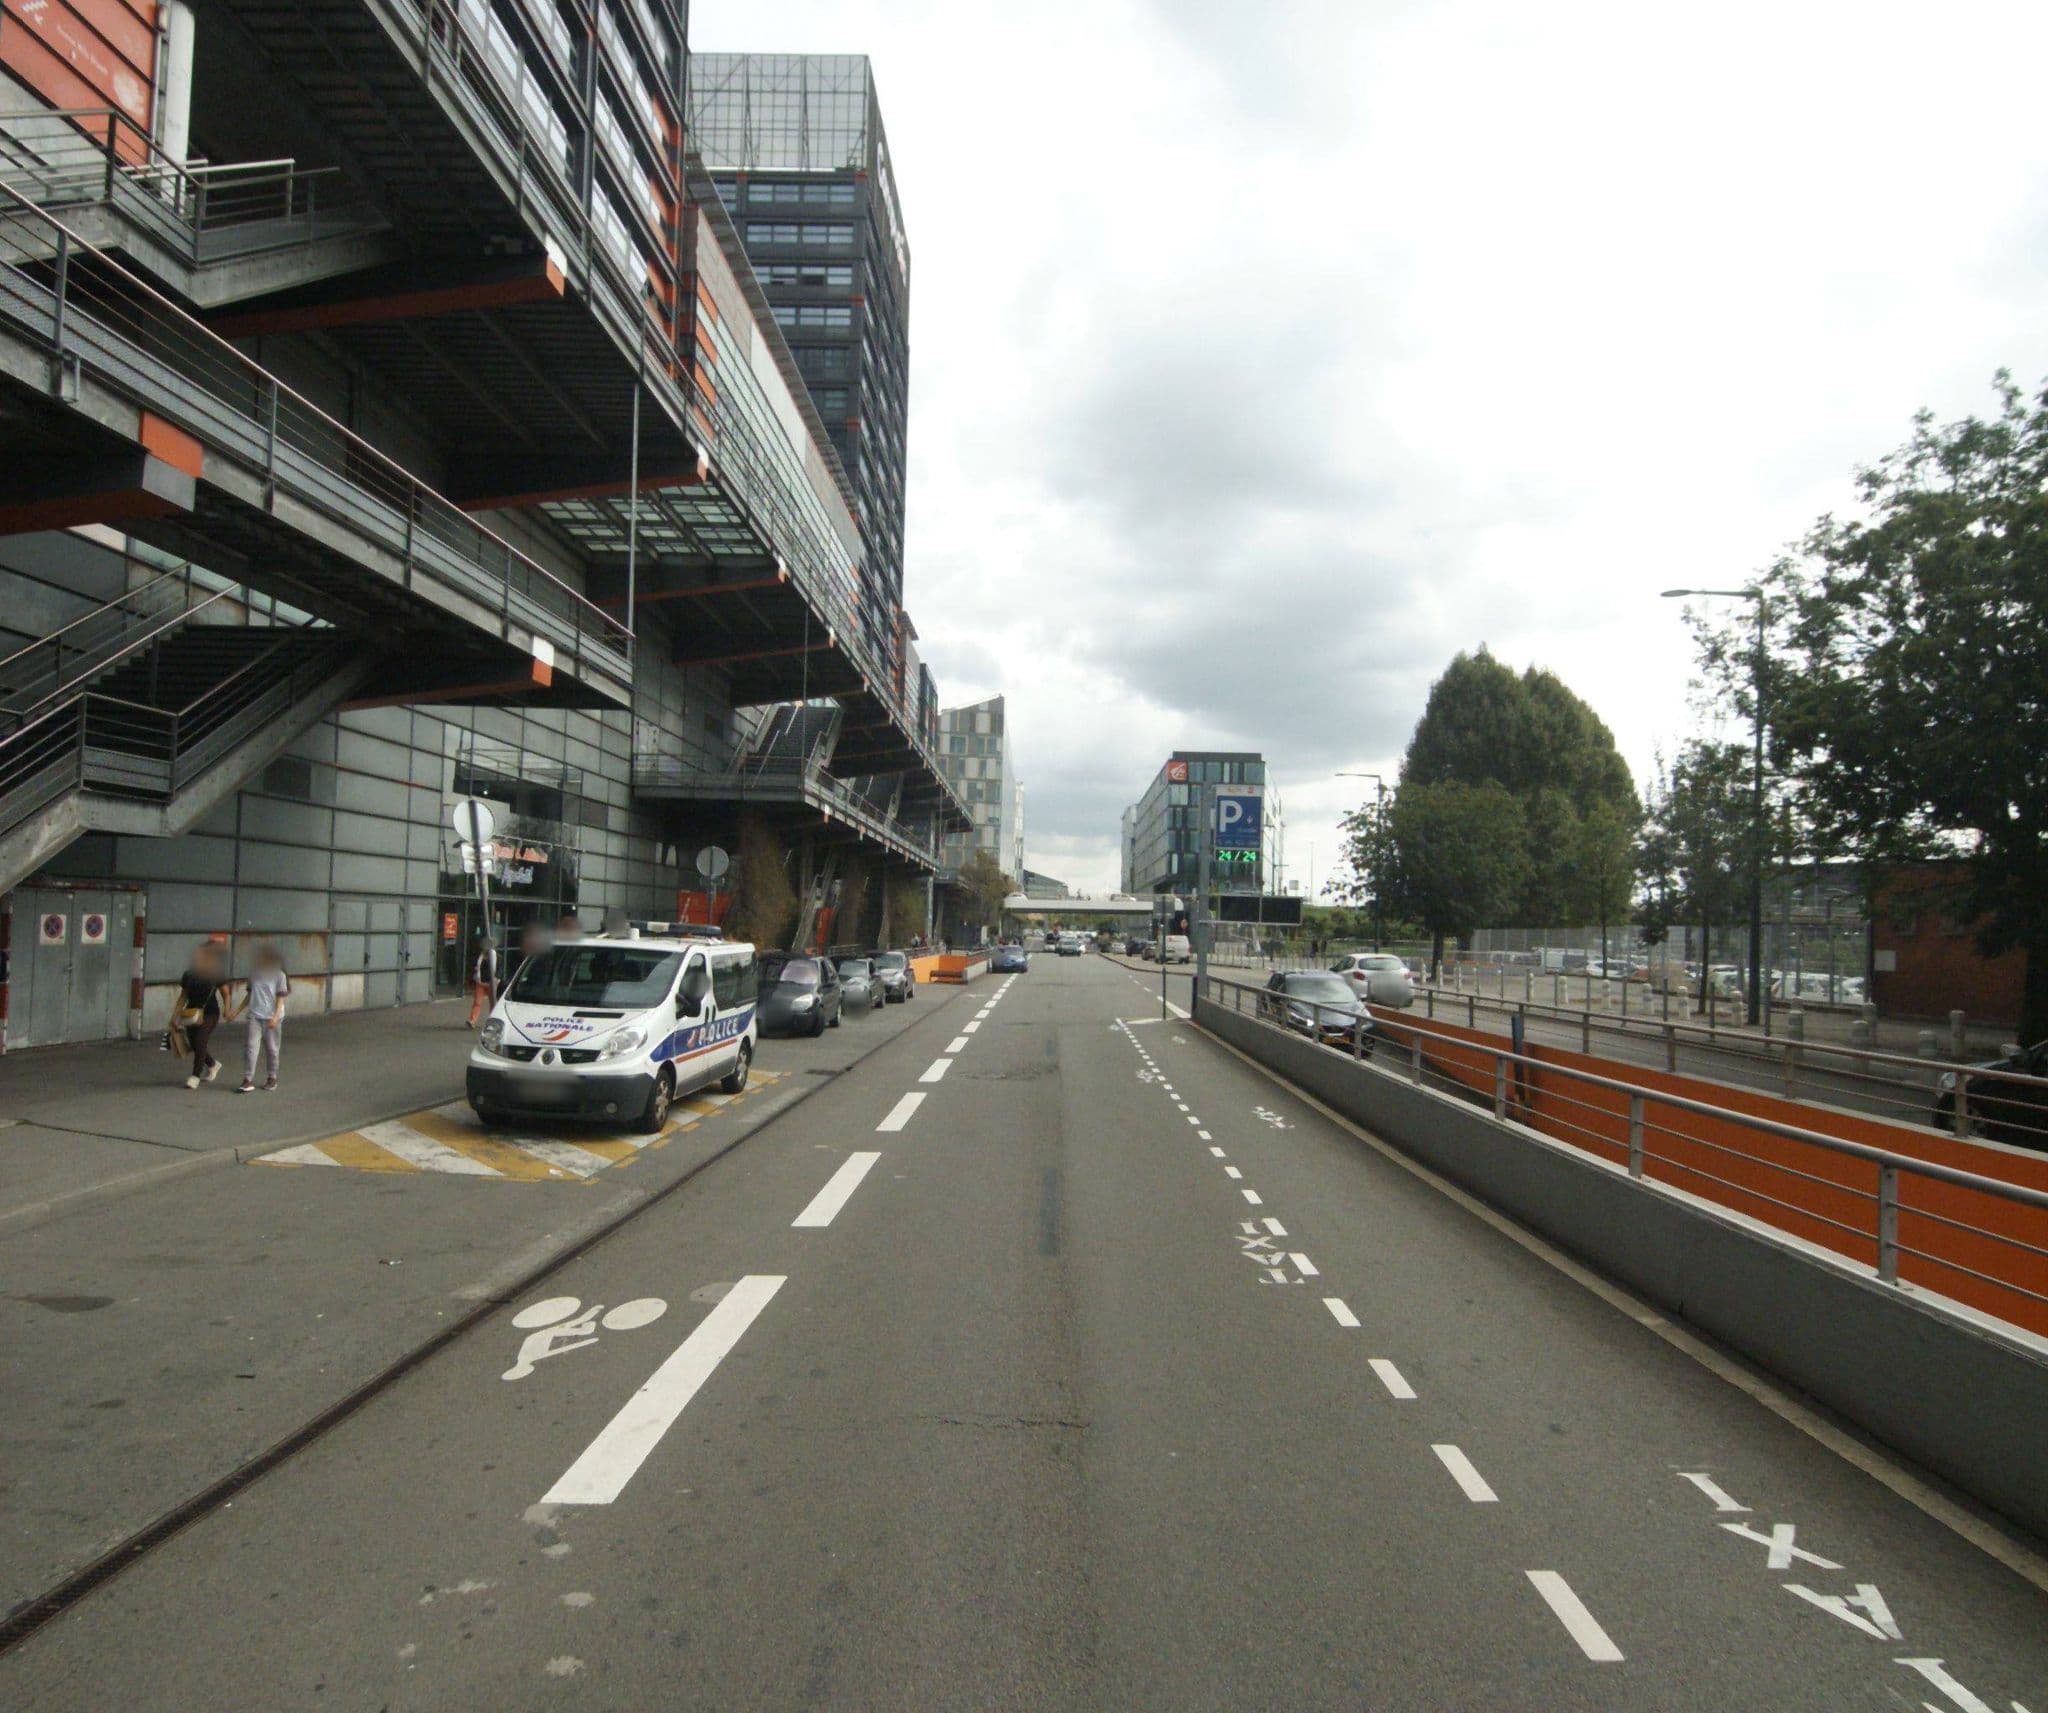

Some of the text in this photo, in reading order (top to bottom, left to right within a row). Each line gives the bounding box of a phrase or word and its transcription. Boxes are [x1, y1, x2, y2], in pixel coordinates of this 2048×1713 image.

[1220, 800, 1243, 832] P
[525, 1022, 594, 1032] NATIONALE
[699, 1018, 738, 1045] POLICE
